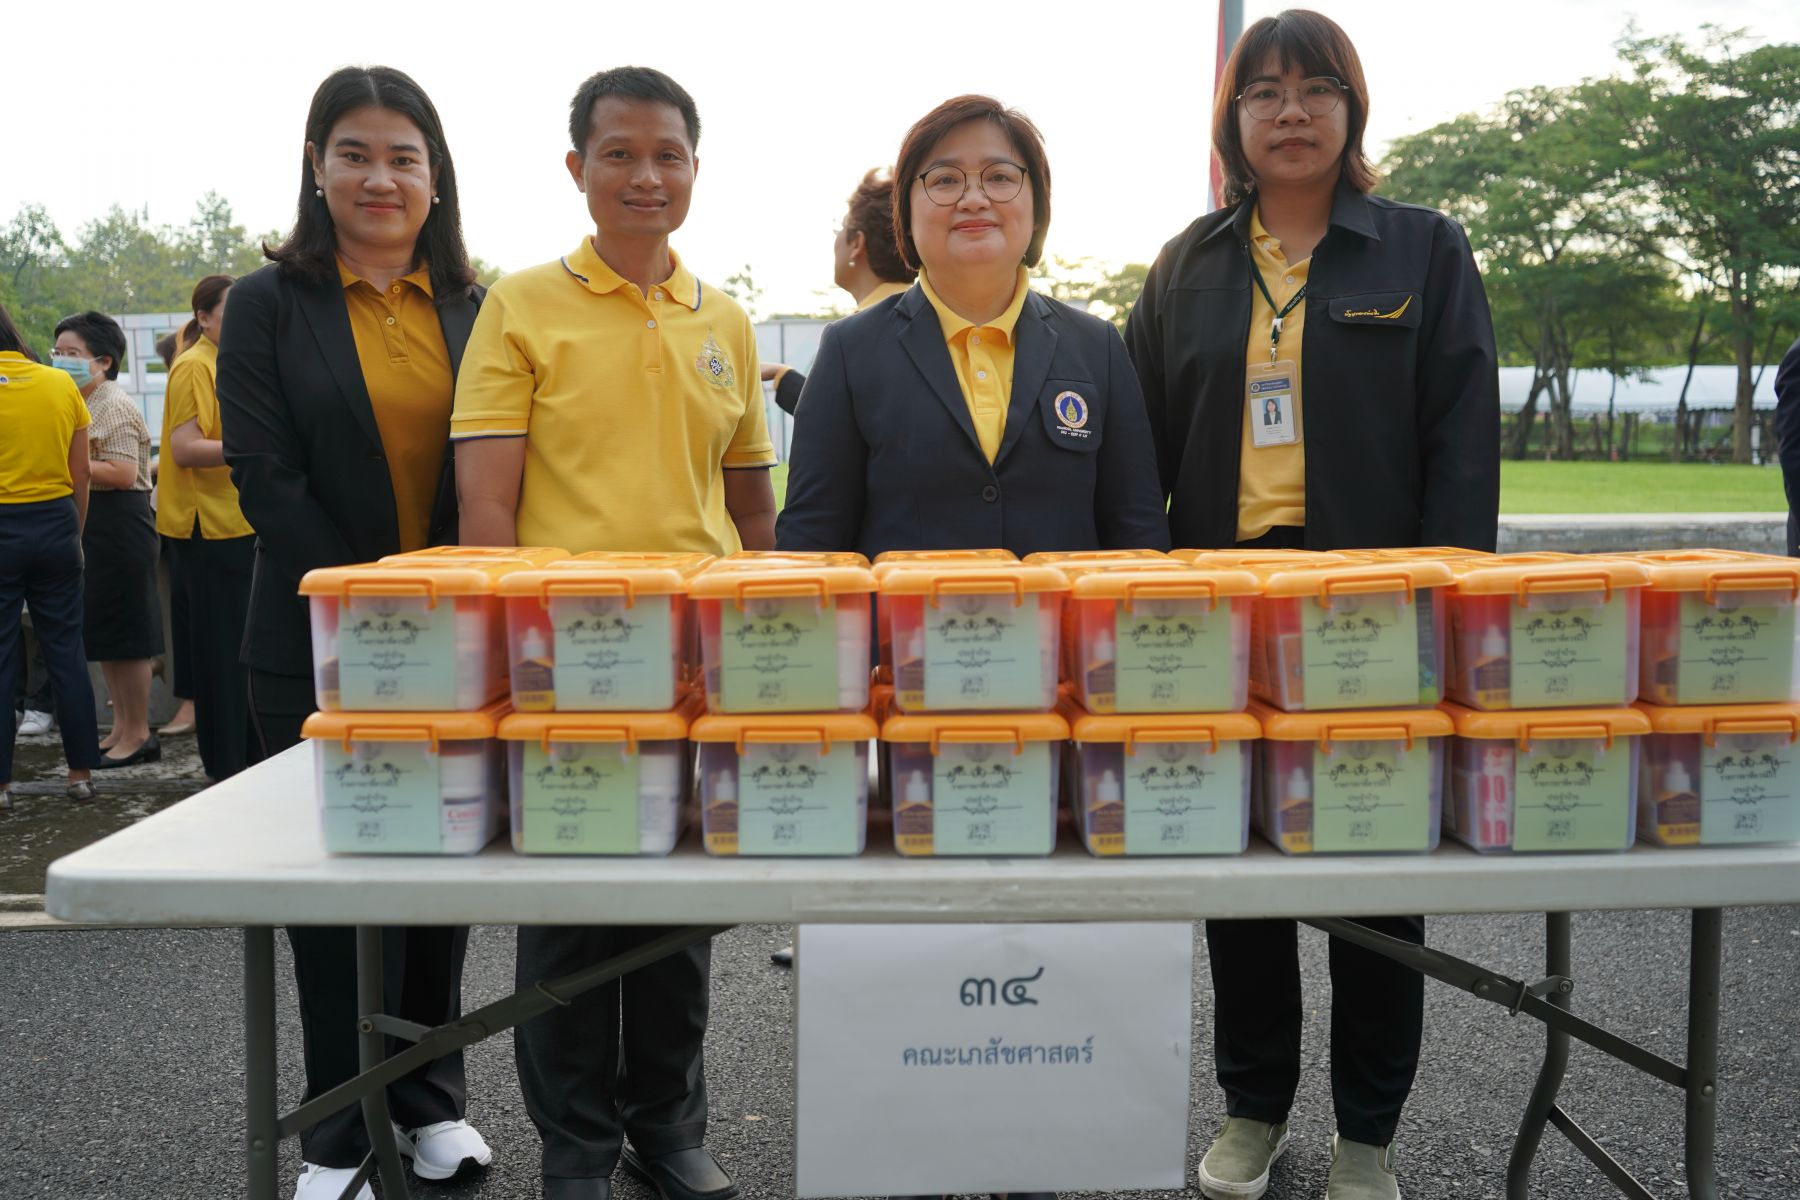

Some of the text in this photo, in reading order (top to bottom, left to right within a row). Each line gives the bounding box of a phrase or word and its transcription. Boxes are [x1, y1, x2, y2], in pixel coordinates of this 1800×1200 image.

[959, 966, 1045, 1007] ๓๔
[903, 1035, 1095, 1067] คณะเภสัชศาสตร์
